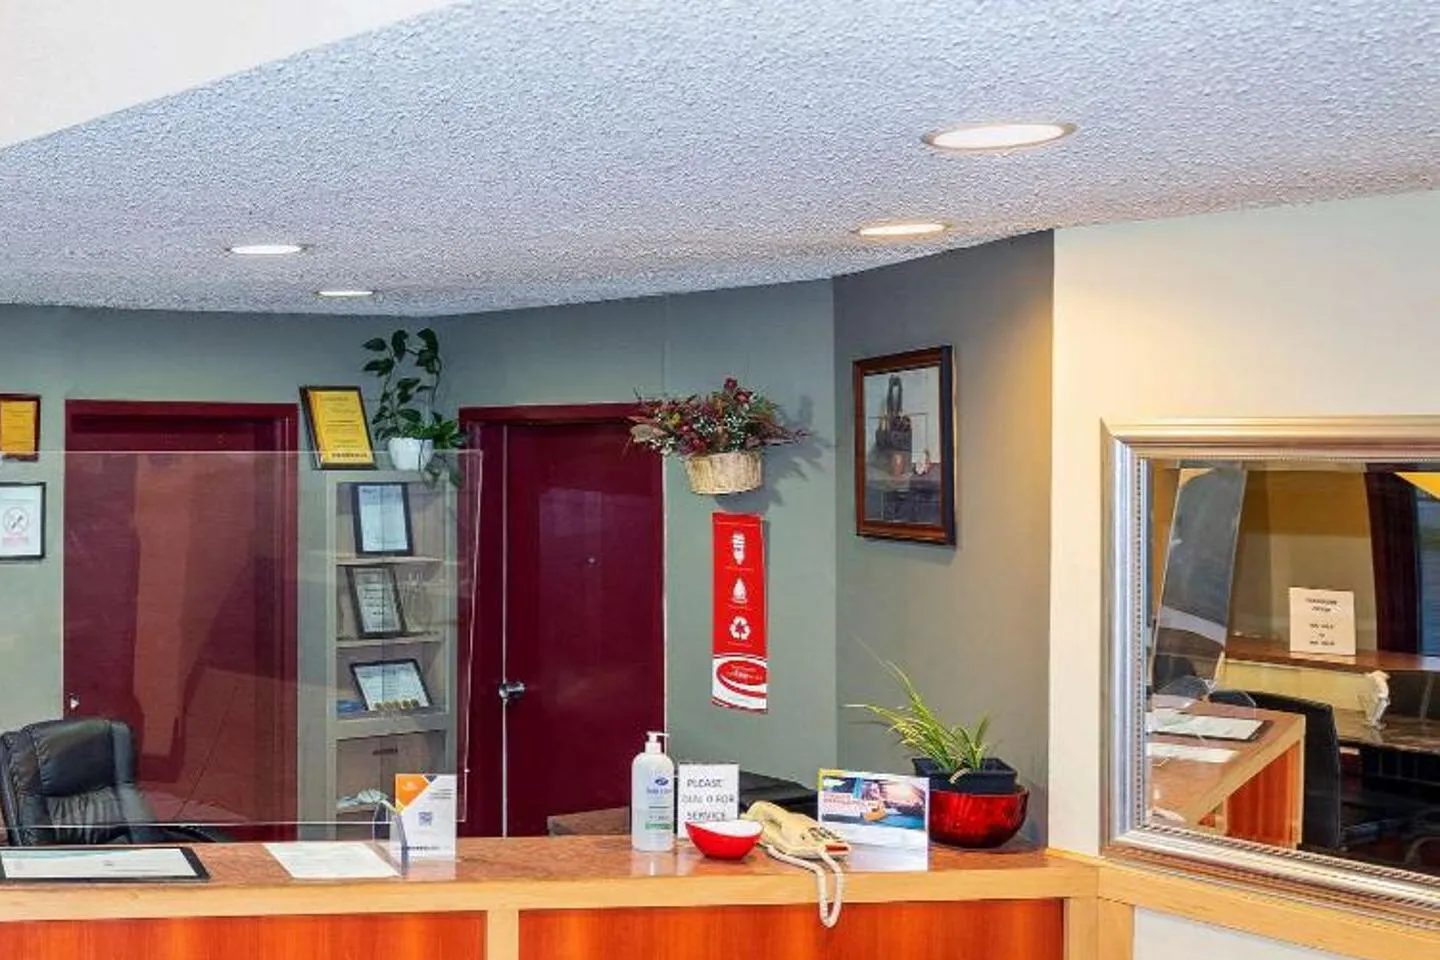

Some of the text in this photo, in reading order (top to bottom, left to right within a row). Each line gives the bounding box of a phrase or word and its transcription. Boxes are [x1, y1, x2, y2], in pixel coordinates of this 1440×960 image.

[687, 779, 723, 788] PLEASE
[715, 794, 735, 804] FOR
[687, 811, 726, 822] SERVICE
